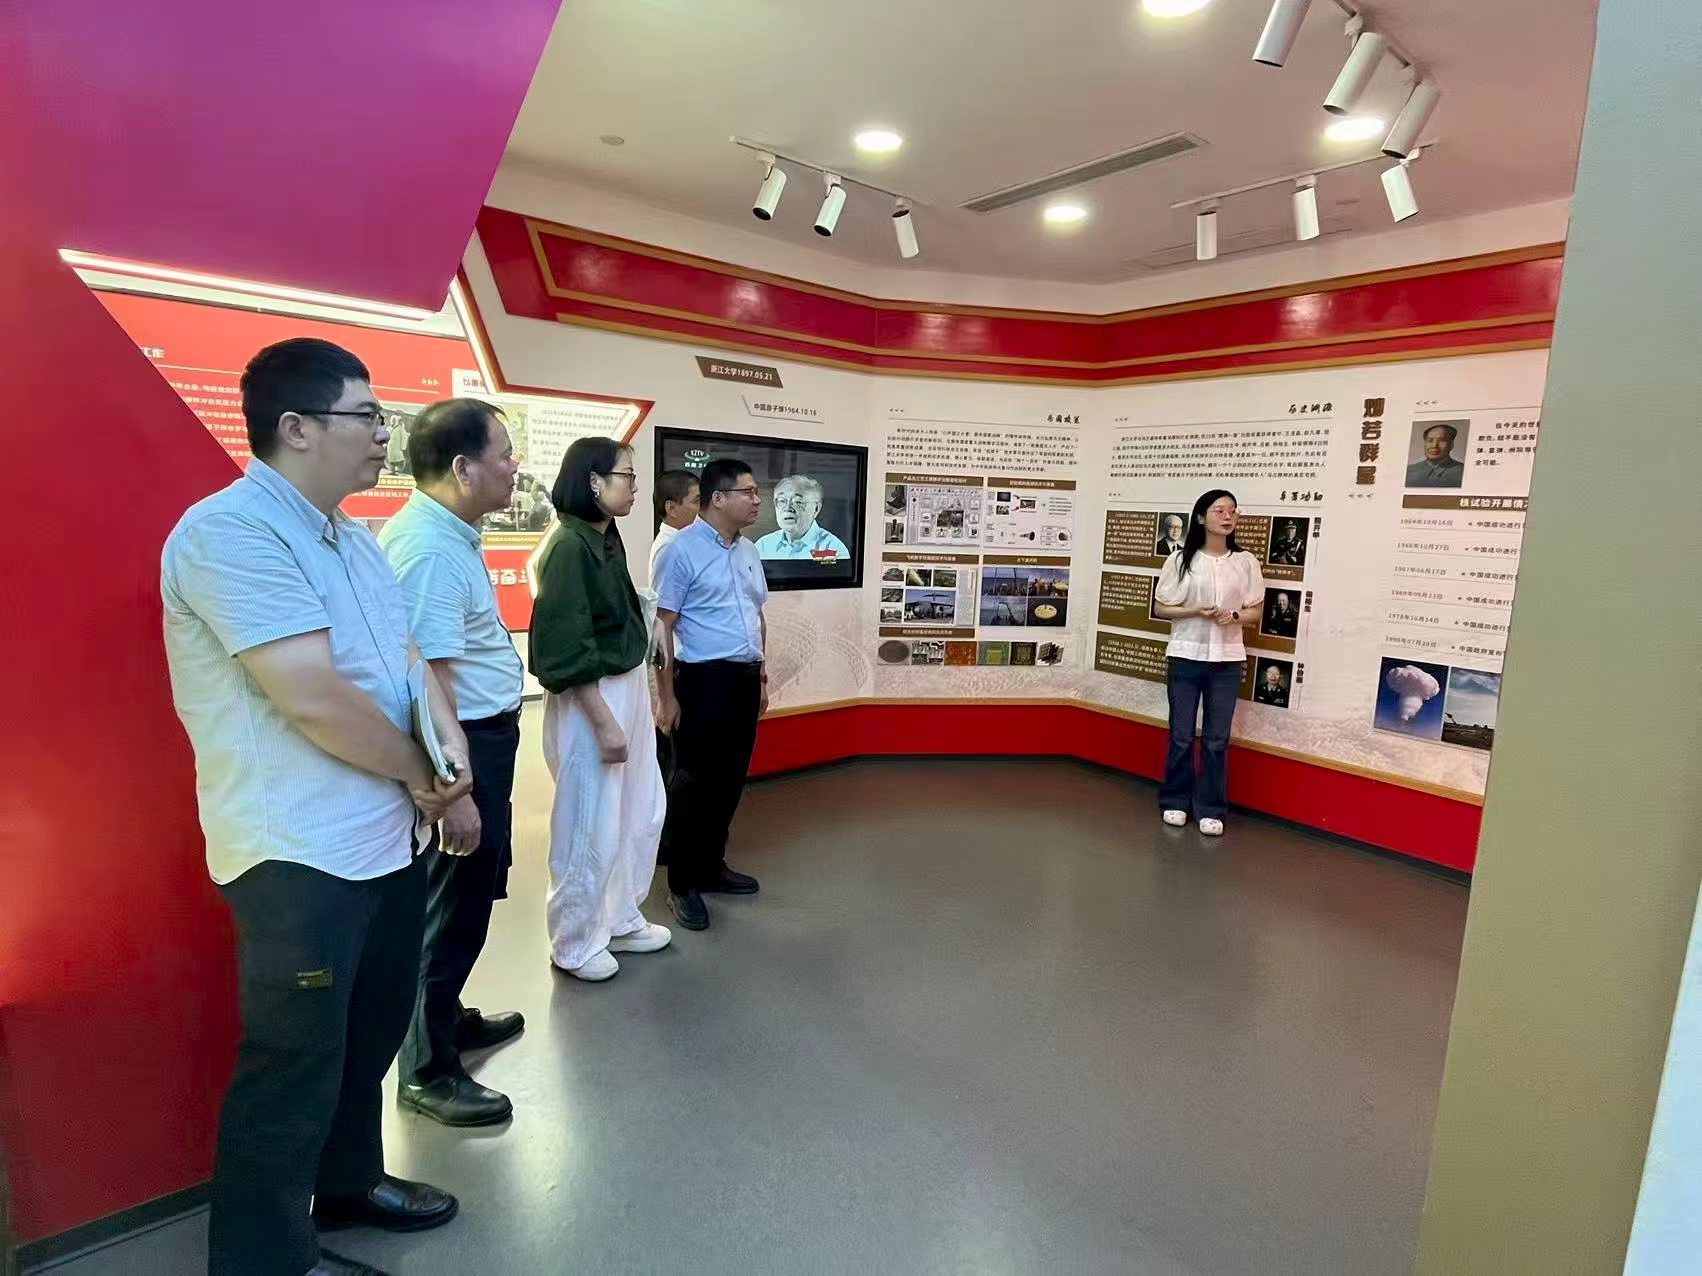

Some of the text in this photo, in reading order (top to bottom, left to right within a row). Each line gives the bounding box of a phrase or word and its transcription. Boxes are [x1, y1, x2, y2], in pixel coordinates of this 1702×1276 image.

[710, 364, 773, 380] 浙江大学1897.05.21
[753, 403, 817, 416] 中国原子弹1964.10.16
[1476, 520, 1526, 529] 中国成功进行
[1469, 571, 1519, 582] 中国成功进行
[1465, 595, 1514, 607] 中国成功进行
[1462, 620, 1511, 633] 中国成功进行
[1459, 644, 1507, 657] 中国政府宣布
